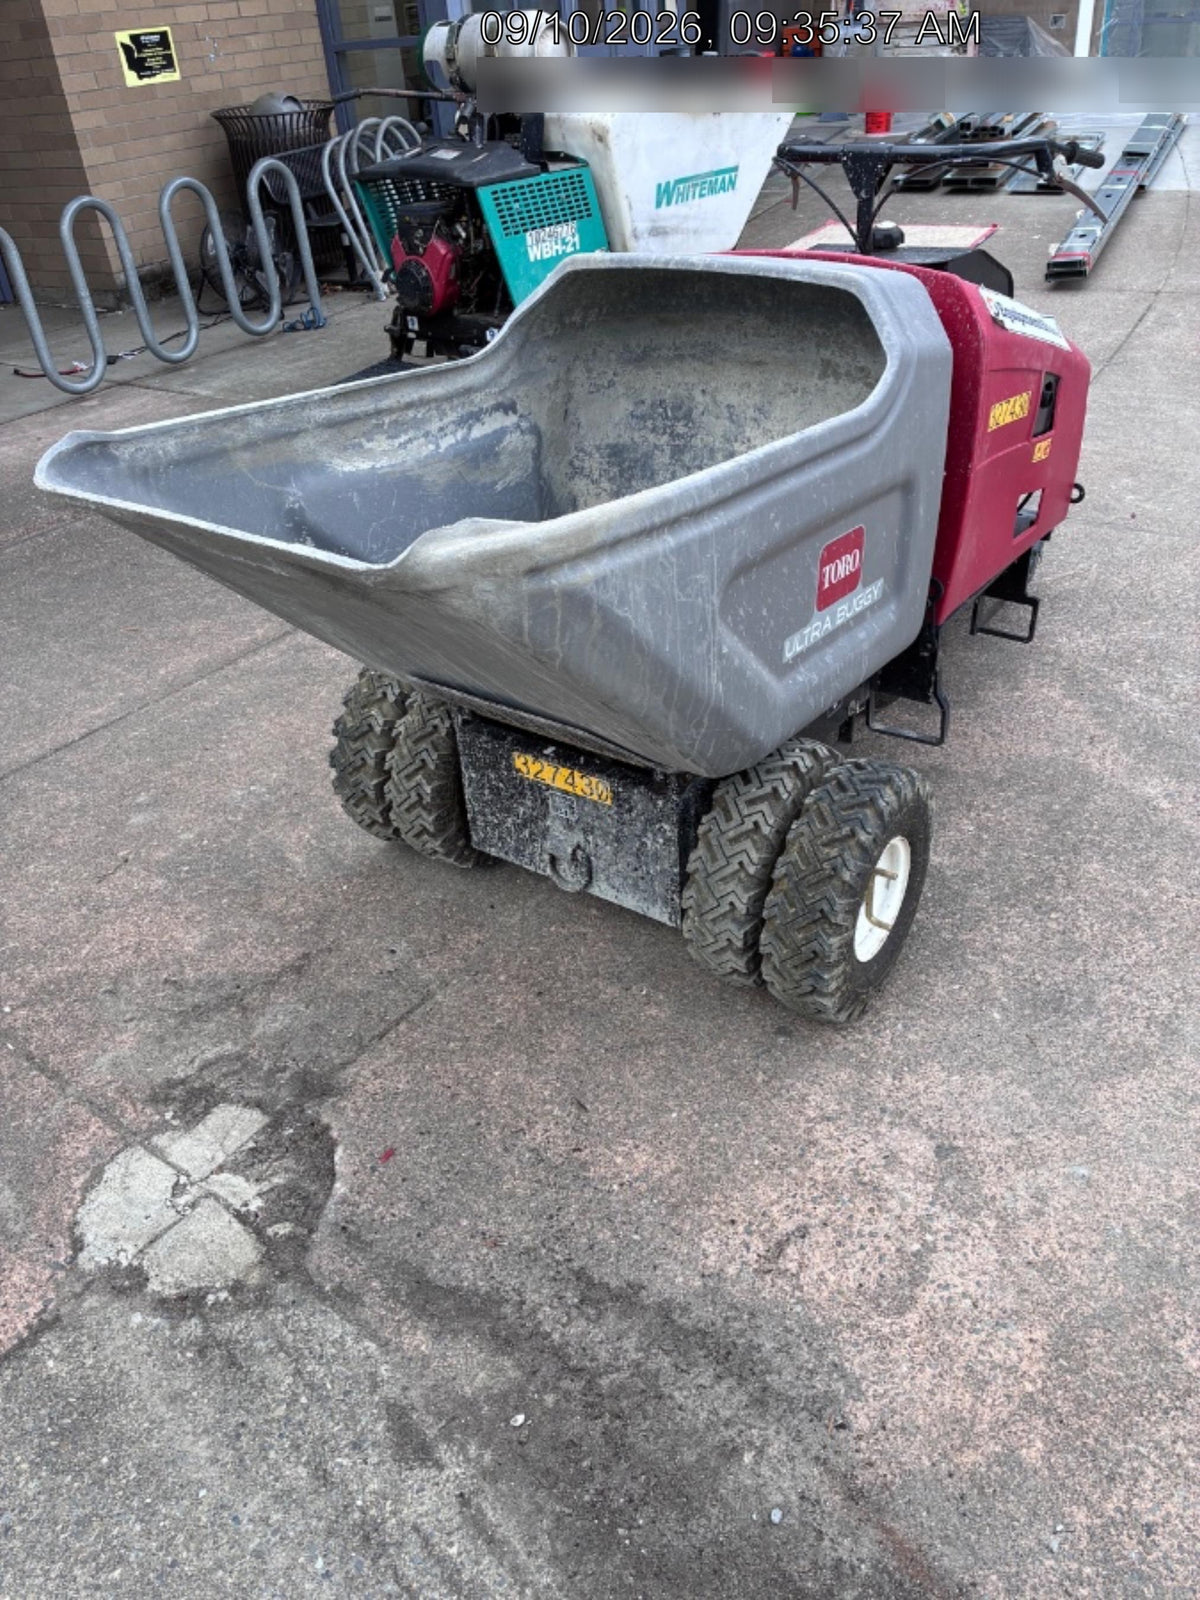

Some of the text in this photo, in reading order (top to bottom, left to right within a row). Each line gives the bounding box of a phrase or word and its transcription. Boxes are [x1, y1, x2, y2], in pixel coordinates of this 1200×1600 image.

[527, 233, 580, 262] WBH-21
[822, 548, 860, 590] TORO
[784, 580, 882, 659] ULTRA BUGGY
[514, 753, 611, 802] 327430
